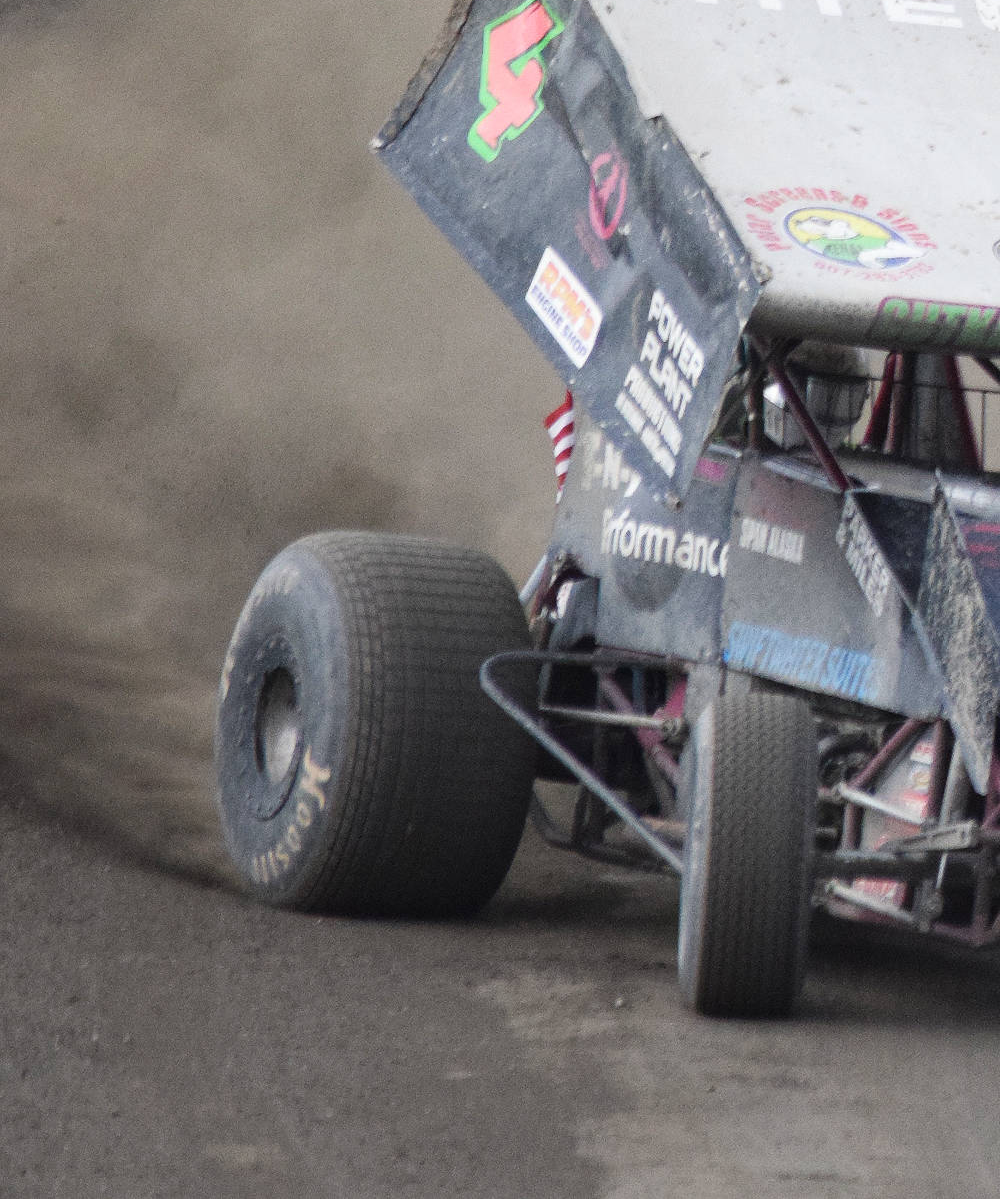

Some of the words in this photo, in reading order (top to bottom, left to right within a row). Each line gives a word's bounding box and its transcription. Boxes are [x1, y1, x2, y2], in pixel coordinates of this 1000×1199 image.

[530, 285, 564, 329] ENGINE
[562, 324, 588, 357] SHOP
[648, 288, 705, 389] POWER
[639, 330, 693, 421] PLANT
